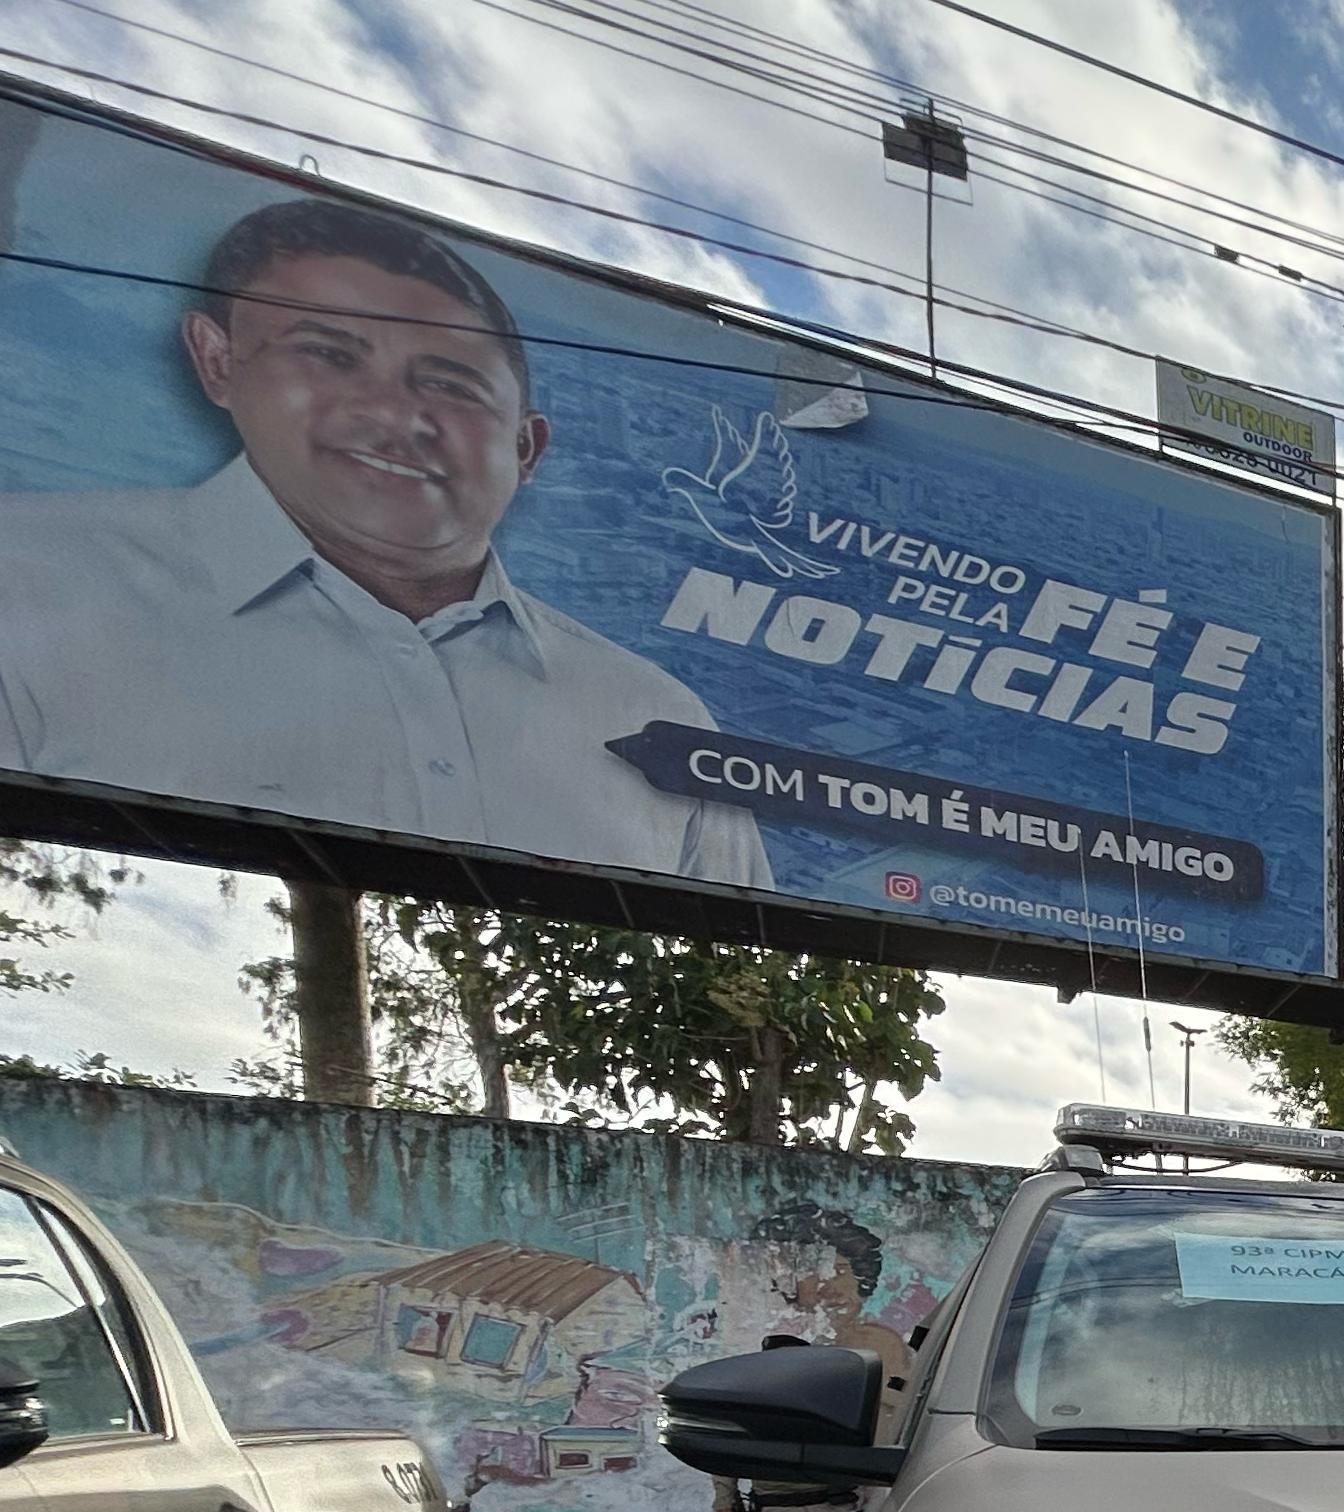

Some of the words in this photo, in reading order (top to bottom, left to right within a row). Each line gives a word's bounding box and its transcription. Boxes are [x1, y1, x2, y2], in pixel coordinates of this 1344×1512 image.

[1187, 384, 1313, 451] VITRINE
[1243, 431, 1312, 462] OUTDOOR
[806, 511, 1025, 595] VIVENDO
[661, 567, 1239, 755] NOTÍCIAS
[888, 576, 1009, 632] PELA
[1019, 579, 1175, 668] FÉ
[1180, 622, 1261, 693] E
[689, 749, 804, 802] COM
[818, 774, 929, 825] TOM
[941, 789, 971, 833] É
[980, 811, 1080, 852] MEU
[1090, 831, 1235, 882] AMIGO
[928, 881, 1187, 945] @tomemeuamigo
